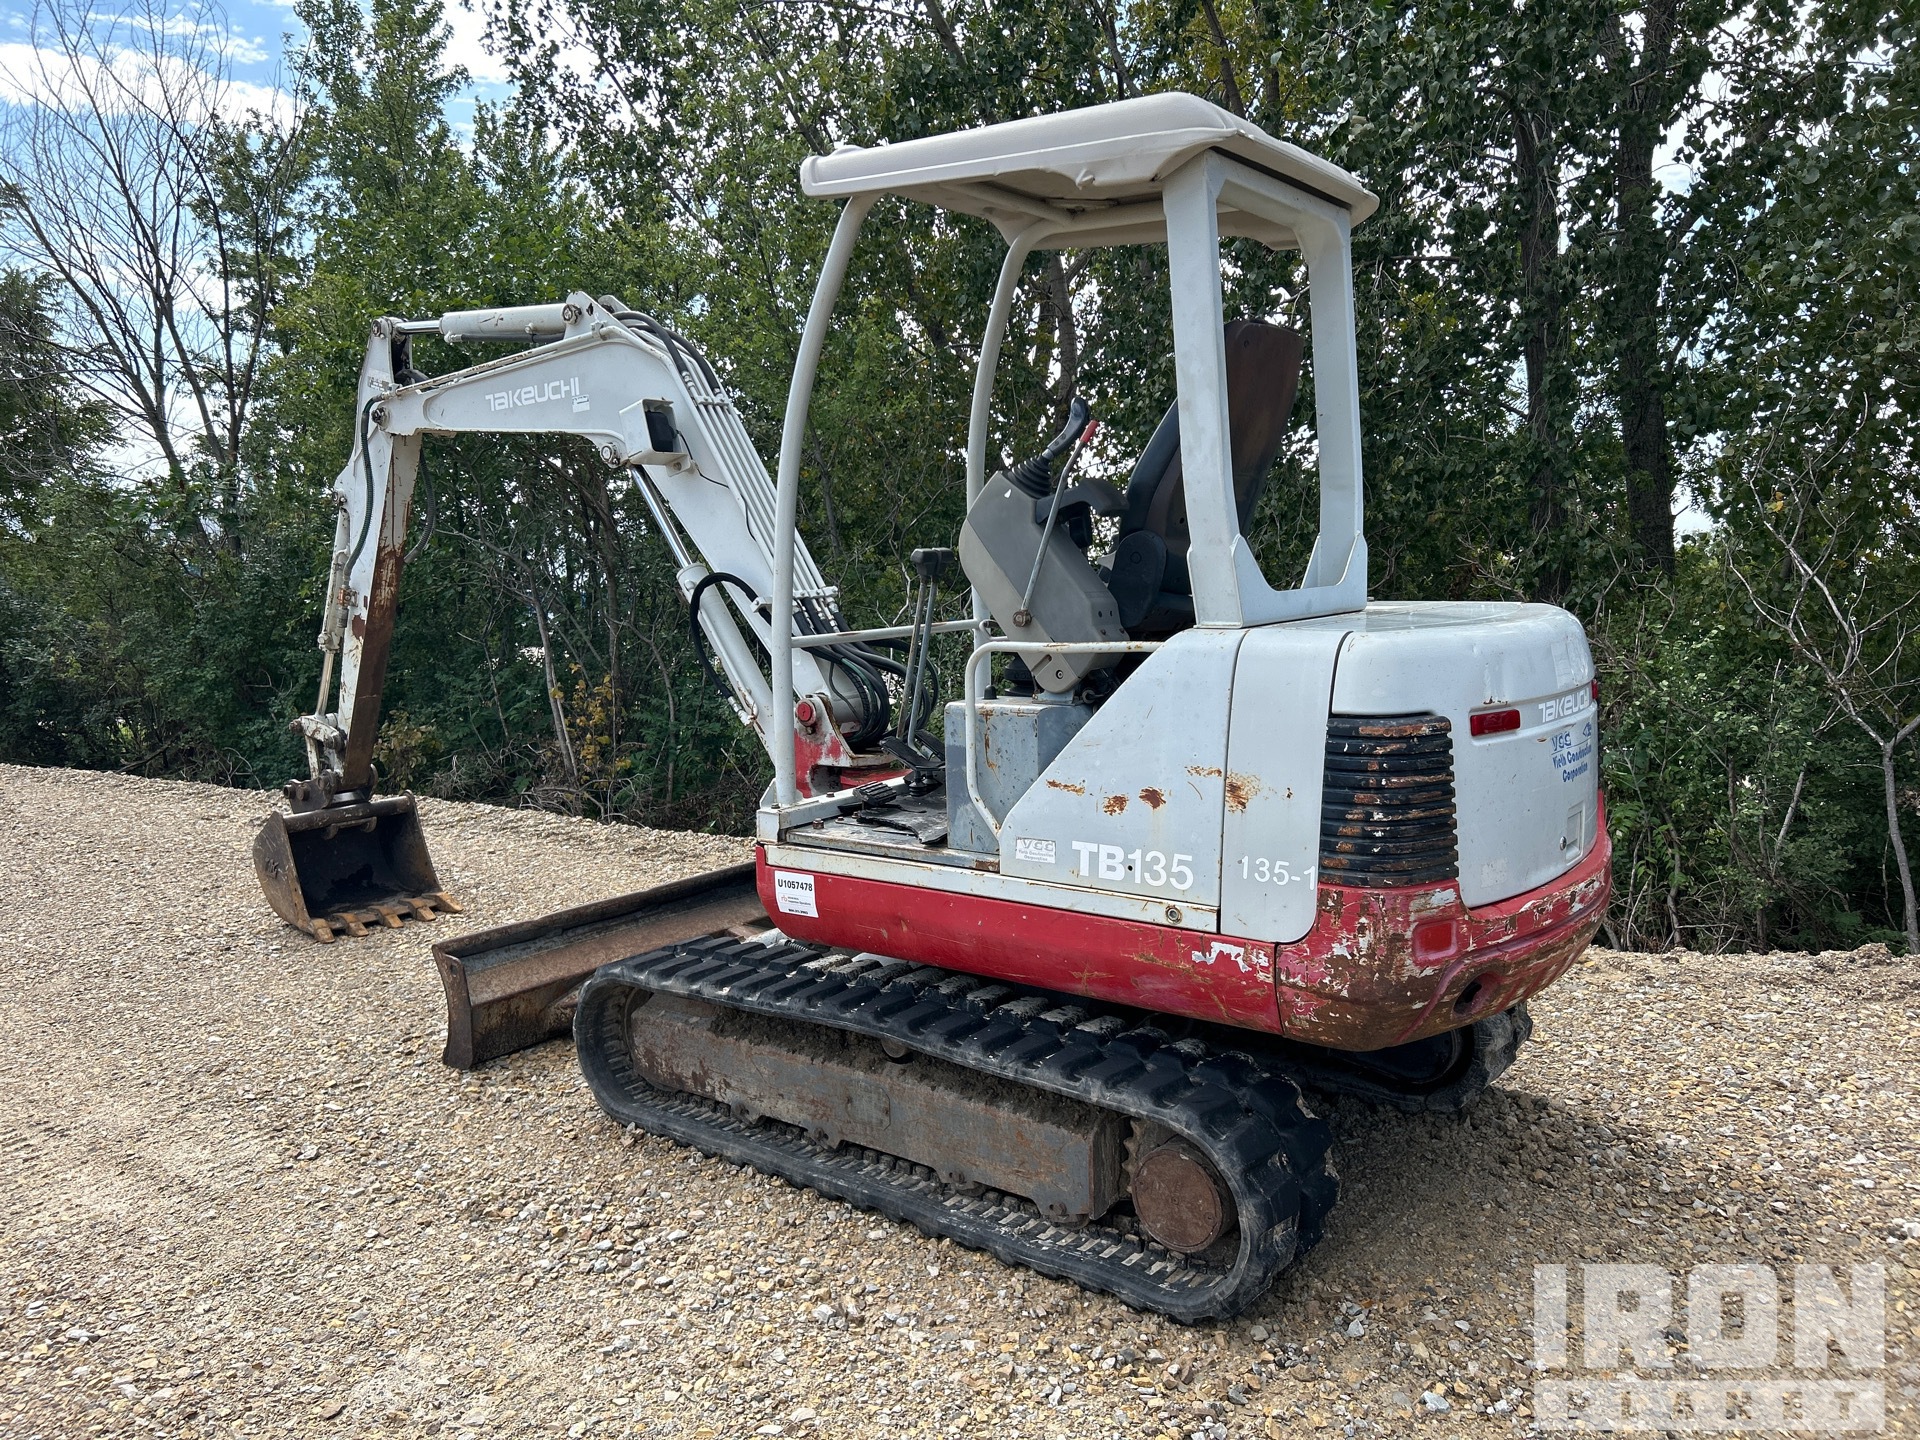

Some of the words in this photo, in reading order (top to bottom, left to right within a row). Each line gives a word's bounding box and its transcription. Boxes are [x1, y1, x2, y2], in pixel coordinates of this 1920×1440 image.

[485, 377, 580, 411] TAKEUCHI
[1072, 840, 1193, 890] TB135
[1239, 855, 1317, 891] 135-1
[778, 879, 813, 891] U1057478
